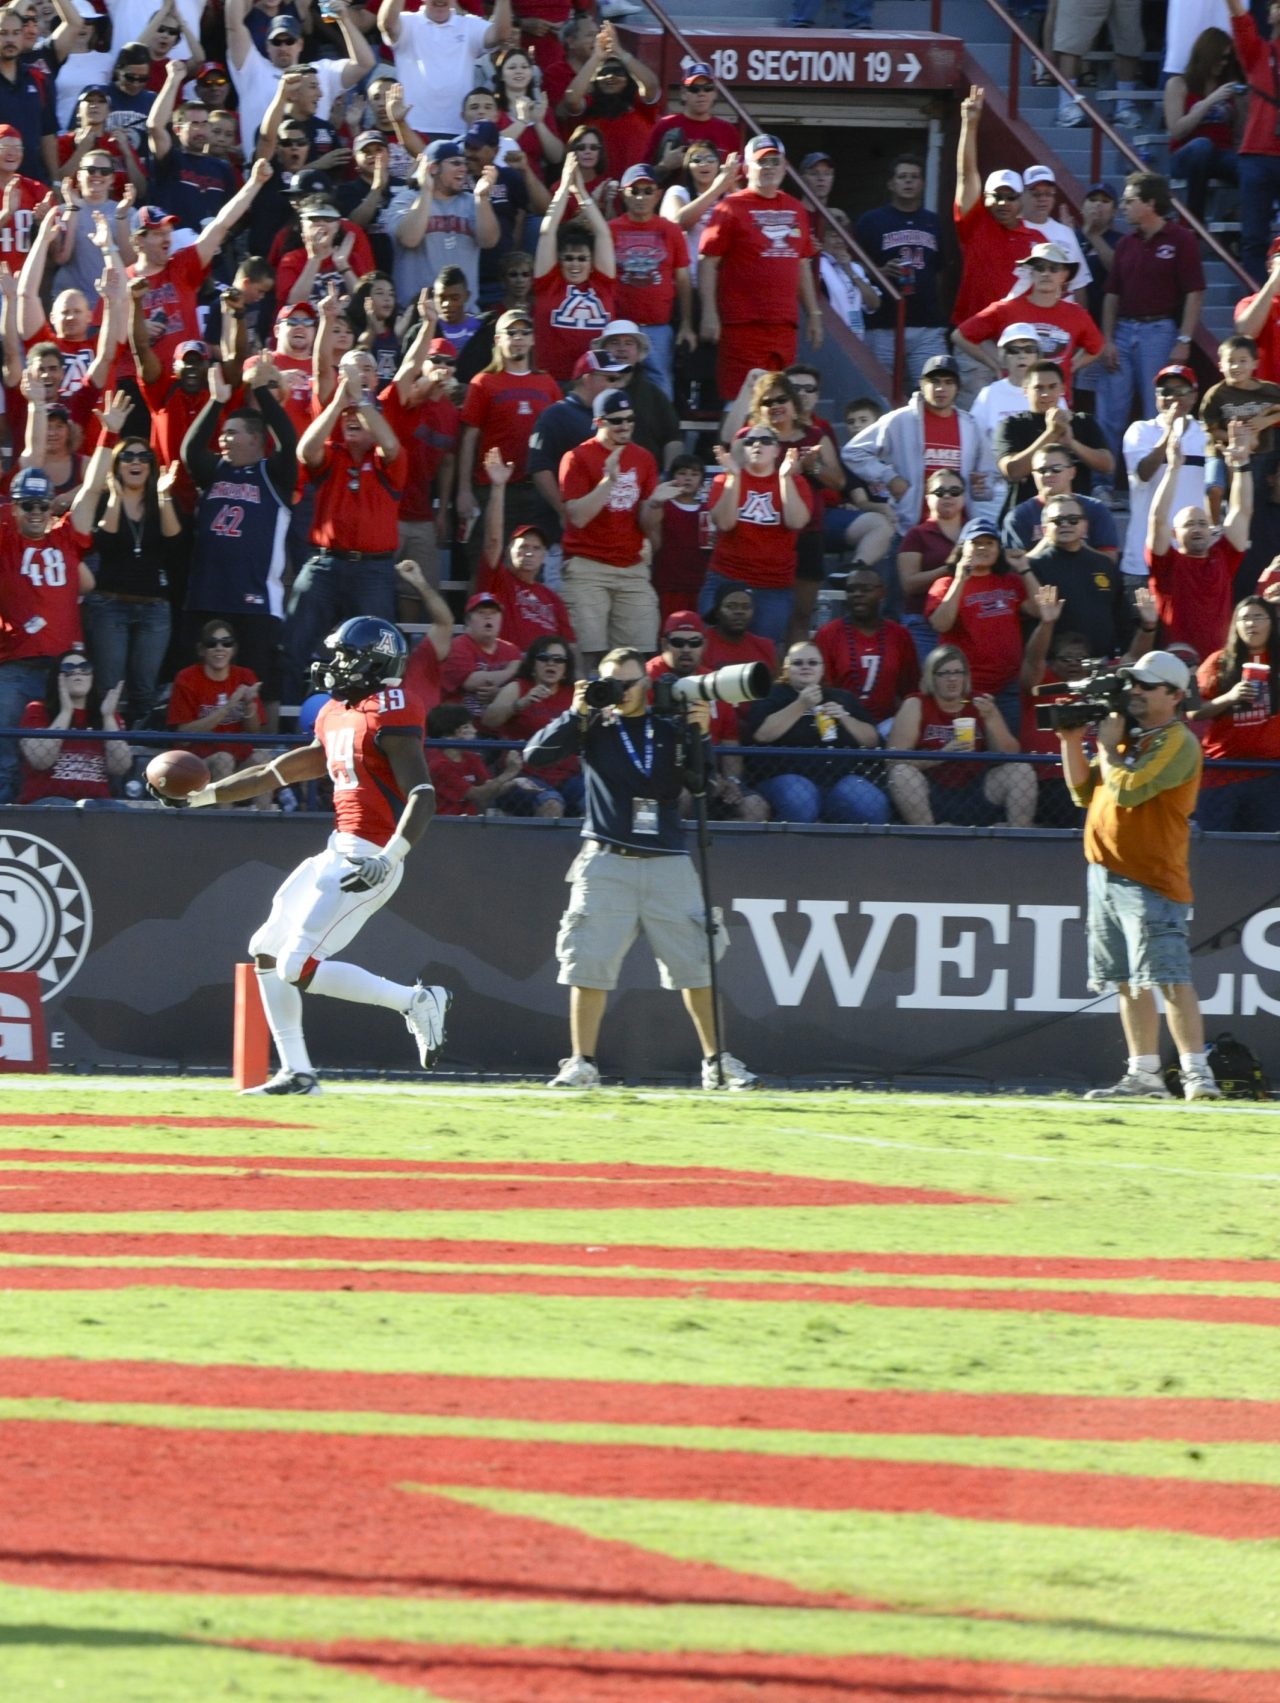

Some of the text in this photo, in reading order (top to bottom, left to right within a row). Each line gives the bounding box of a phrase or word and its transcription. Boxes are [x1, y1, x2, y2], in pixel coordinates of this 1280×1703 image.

[710, 49, 891, 82] 18 SECTION 19
[551, 285, 611, 330] A
[210, 504, 245, 537] 42
[736, 490, 781, 526] A
[20, 547, 67, 586] 48
[371, 628, 398, 657] A
[860, 655, 882, 693] 7
[377, 688, 405, 713] 19
[326, 728, 359, 791] 19
[732, 898, 1280, 1016] WEL
